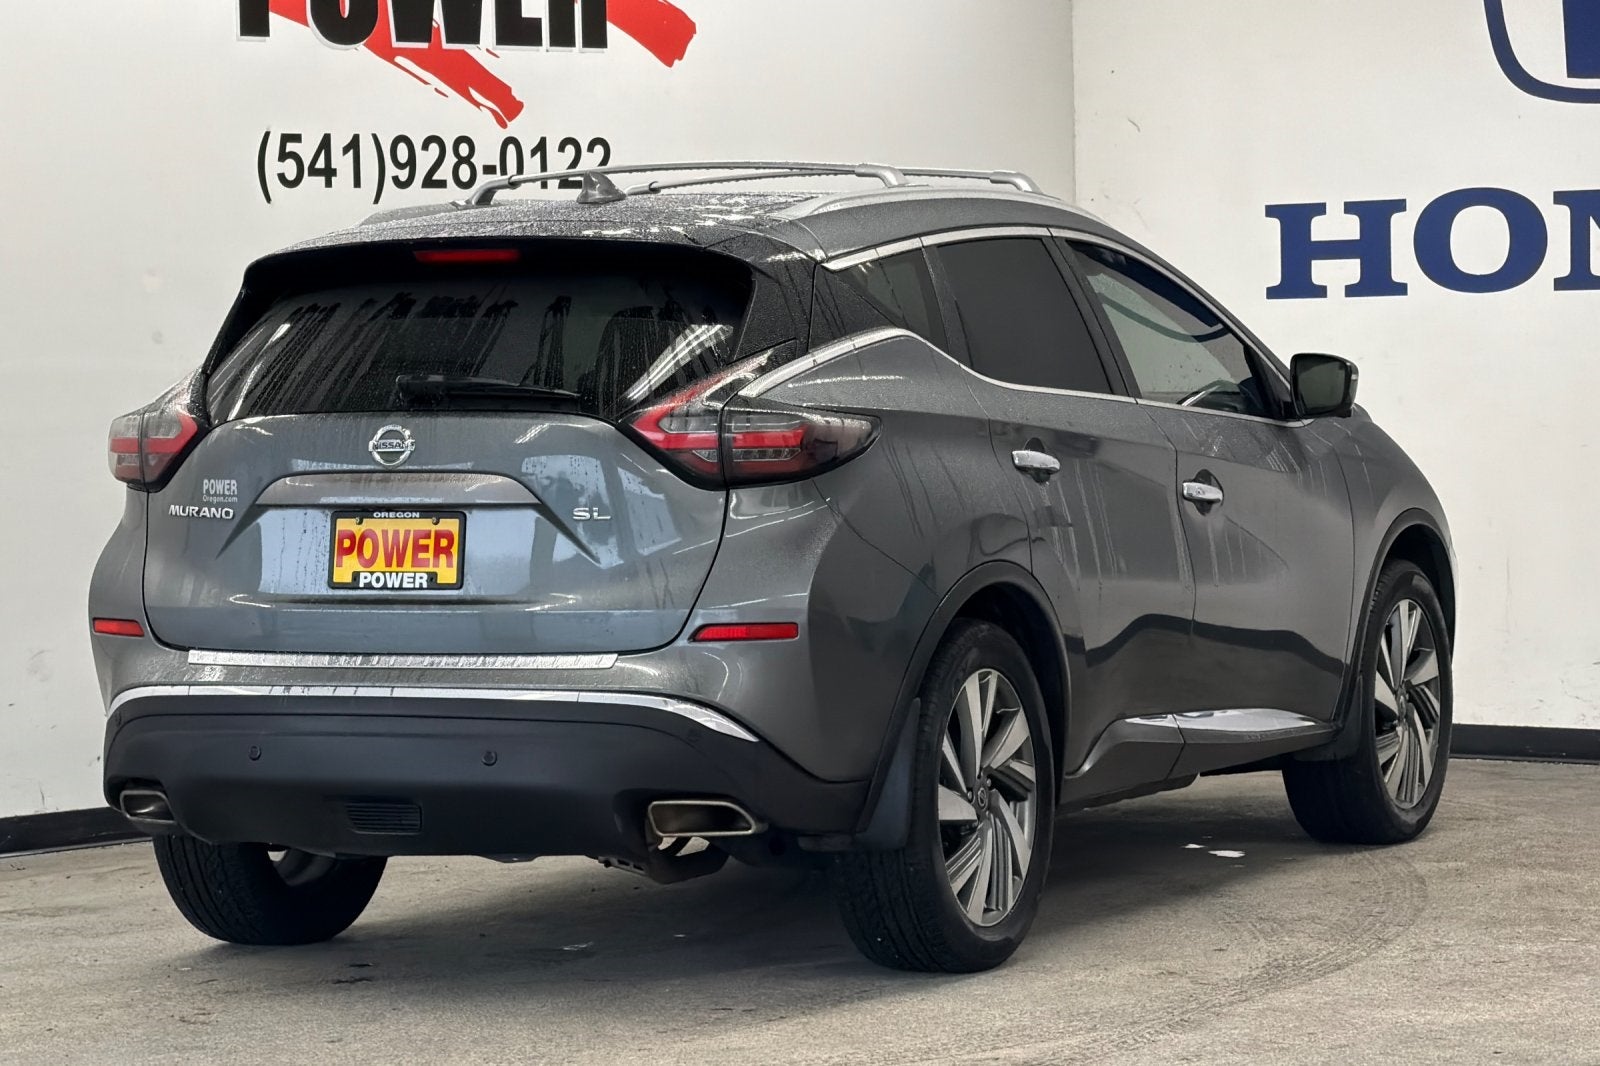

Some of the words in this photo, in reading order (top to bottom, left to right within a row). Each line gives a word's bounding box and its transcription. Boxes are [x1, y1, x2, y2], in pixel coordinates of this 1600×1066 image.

[203, 479, 238, 495] POWER
[202, 494, 238, 504] Oregon.com
[168, 504, 234, 520] MURANO
[572, 507, 611, 520] SL
[336, 528, 455, 569] POWER
[359, 572, 428, 588] POWER
